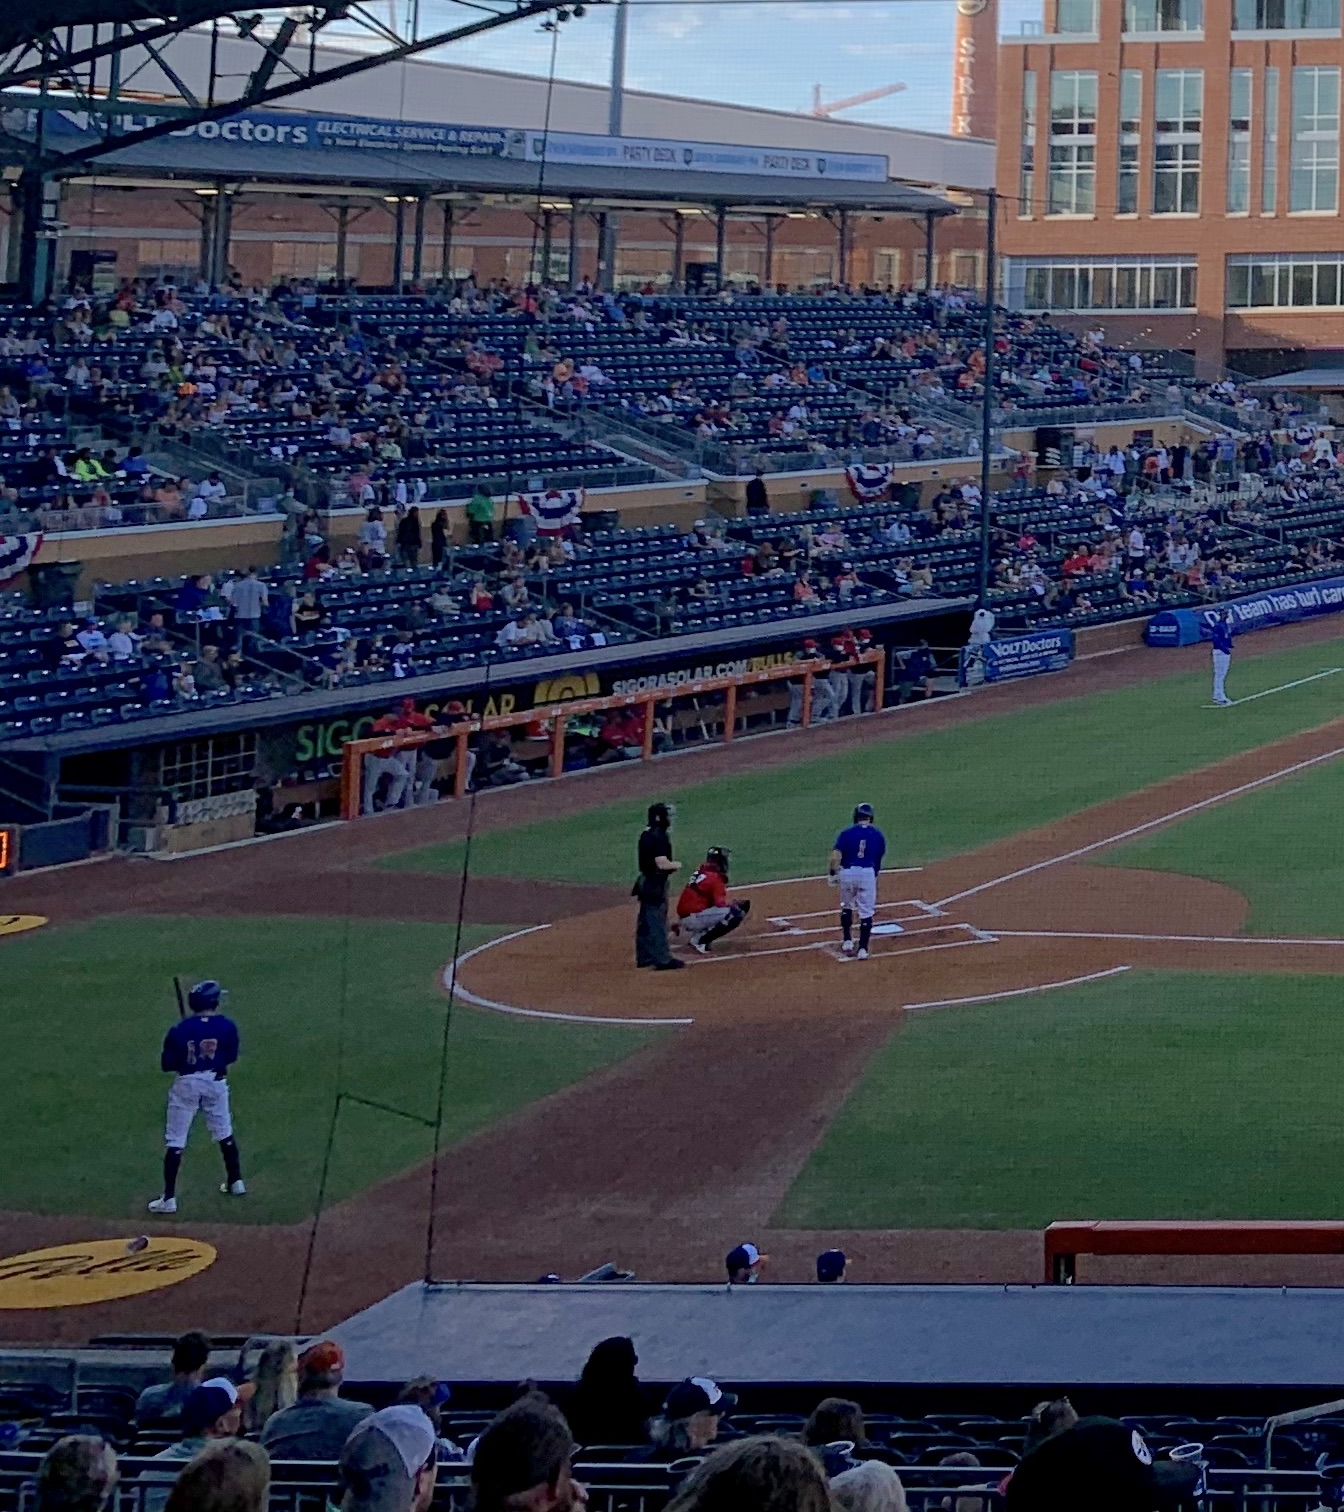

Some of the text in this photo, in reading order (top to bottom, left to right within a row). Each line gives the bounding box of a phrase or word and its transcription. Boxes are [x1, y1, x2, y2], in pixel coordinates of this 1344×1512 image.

[316, 121, 393, 137] ELECTRICAL
[395, 126, 445, 140] SERVICE
[1204, 609, 1233, 627] Or
[1233, 599, 1272, 622] team
[1272, 592, 1297, 611] has
[1297, 589, 1320, 607] turf
[425, 694, 516, 721] SLAR
